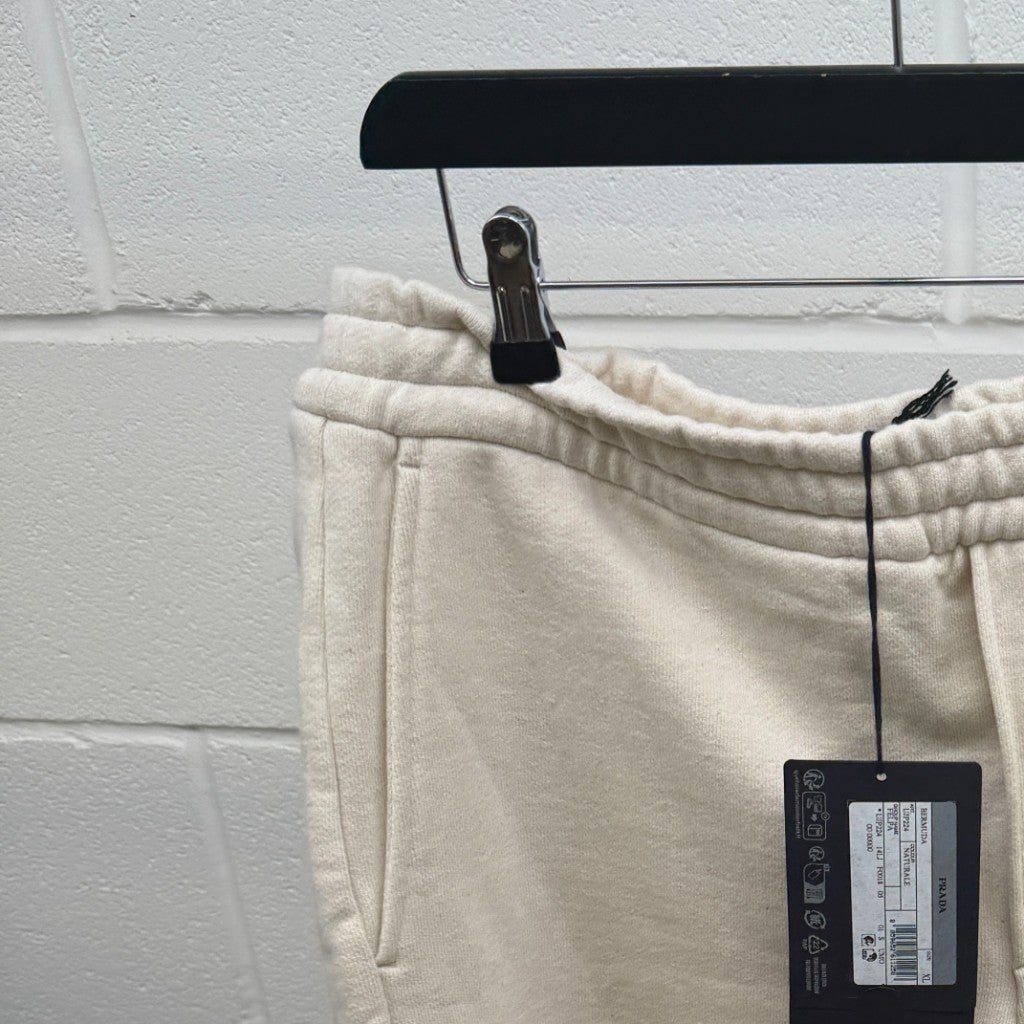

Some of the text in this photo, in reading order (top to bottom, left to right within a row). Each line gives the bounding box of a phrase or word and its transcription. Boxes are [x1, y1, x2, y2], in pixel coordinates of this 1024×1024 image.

[886, 808, 894, 831] FELPA
[920, 807, 928, 845] BERMUDA
[938, 877, 947, 914] PRADA
[922, 973, 930, 983] XL
